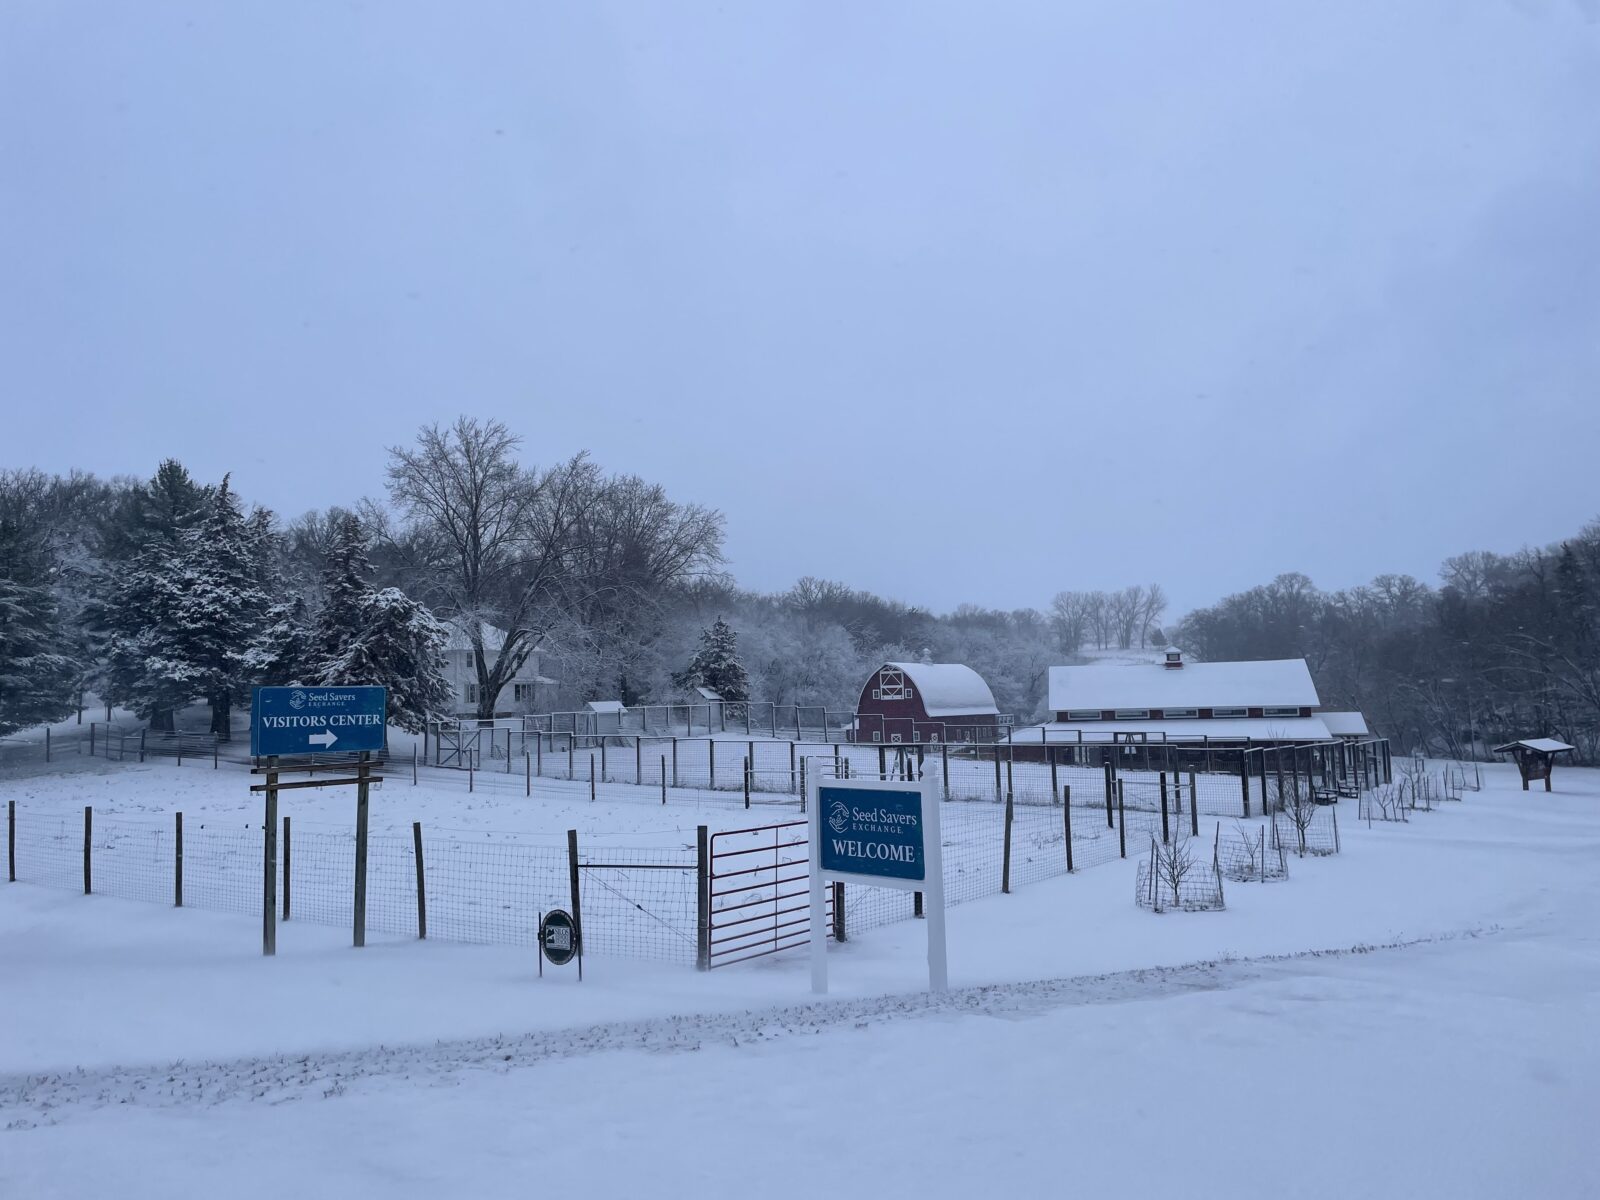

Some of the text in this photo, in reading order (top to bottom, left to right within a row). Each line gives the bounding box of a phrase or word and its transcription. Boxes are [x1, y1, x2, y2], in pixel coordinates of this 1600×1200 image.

[308, 692, 356, 701] Seed Savers
[263, 714, 382, 728] VISITORS CENTER
[852, 807, 917, 825] Seed Savers
[852, 823, 904, 834] EXCHANGE
[832, 839, 915, 862] WELCOME
